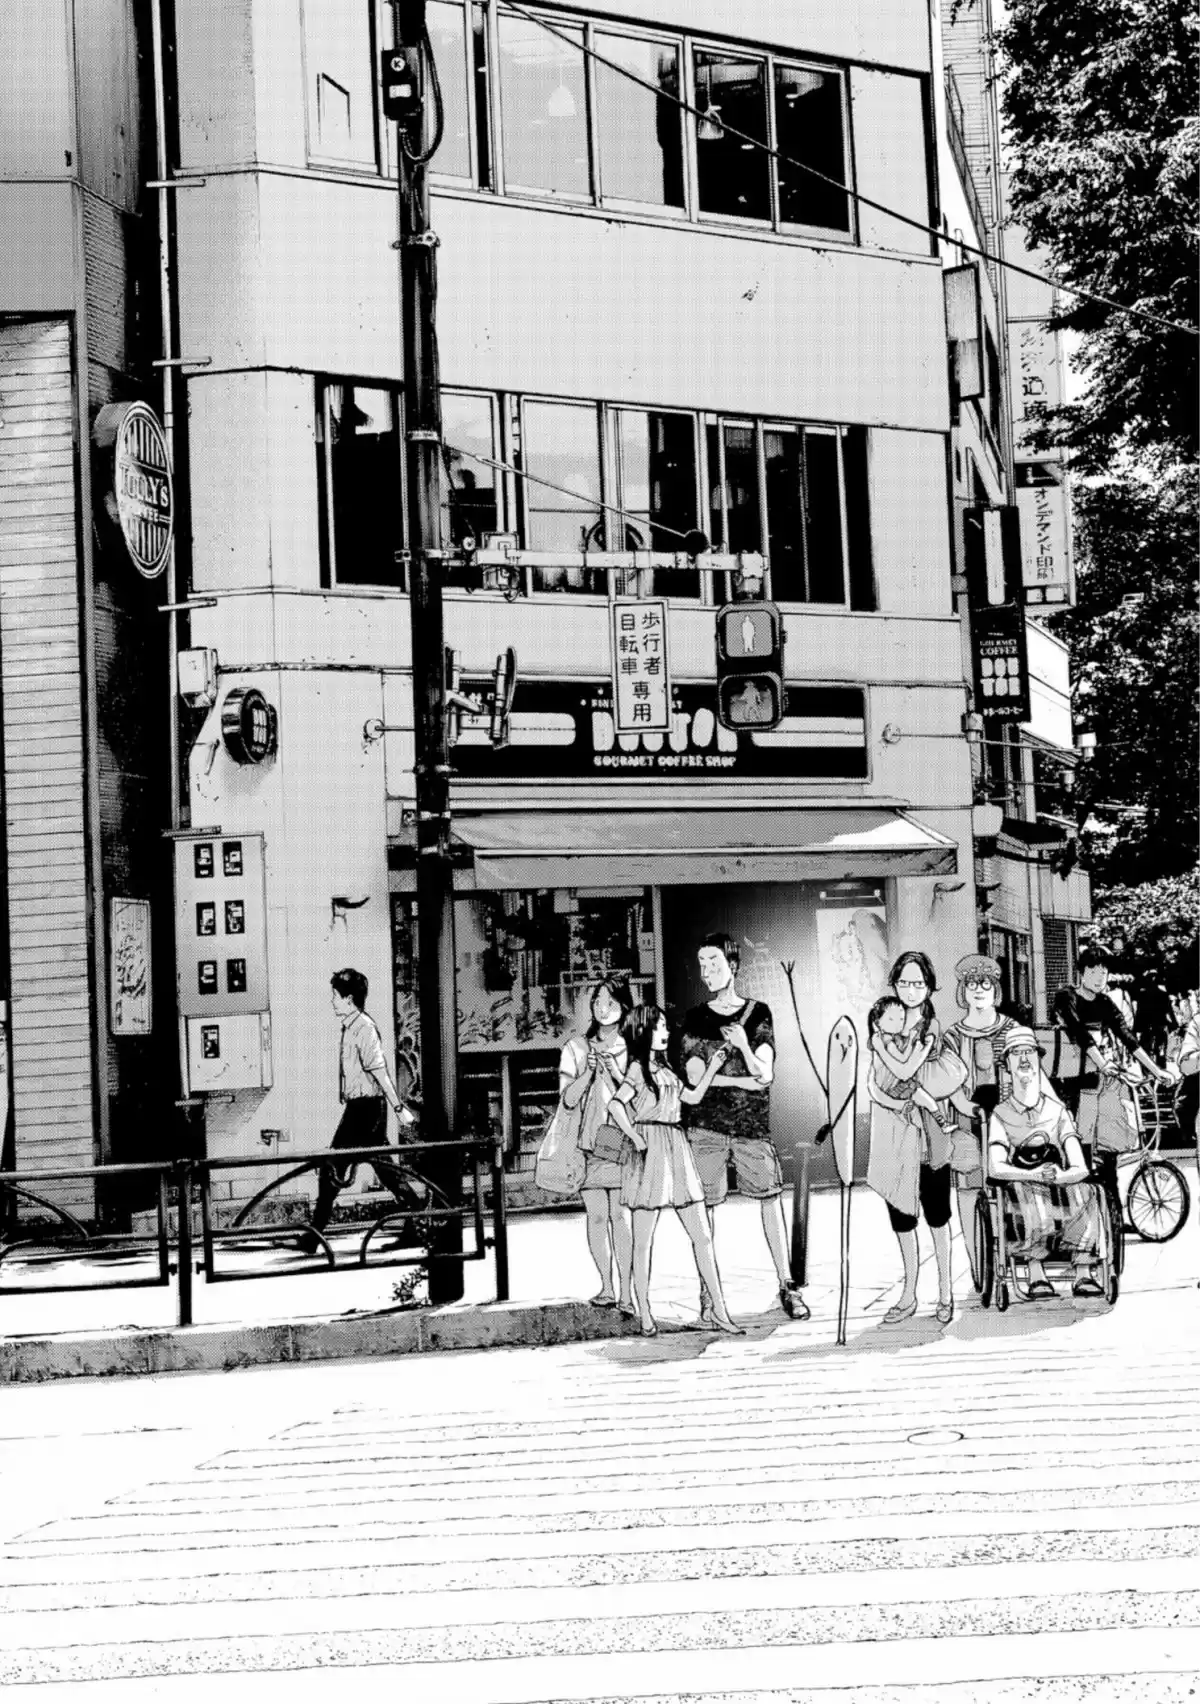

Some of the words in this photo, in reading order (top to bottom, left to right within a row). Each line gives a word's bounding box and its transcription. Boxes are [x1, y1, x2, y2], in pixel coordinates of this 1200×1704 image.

[642, 611, 660, 675] 歩行者
[632, 681, 651, 722] 専用
[593, 755, 655, 768] GOURMET
[657, 754, 704, 768] COFFEE
[705, 754, 737, 768] SHOP
